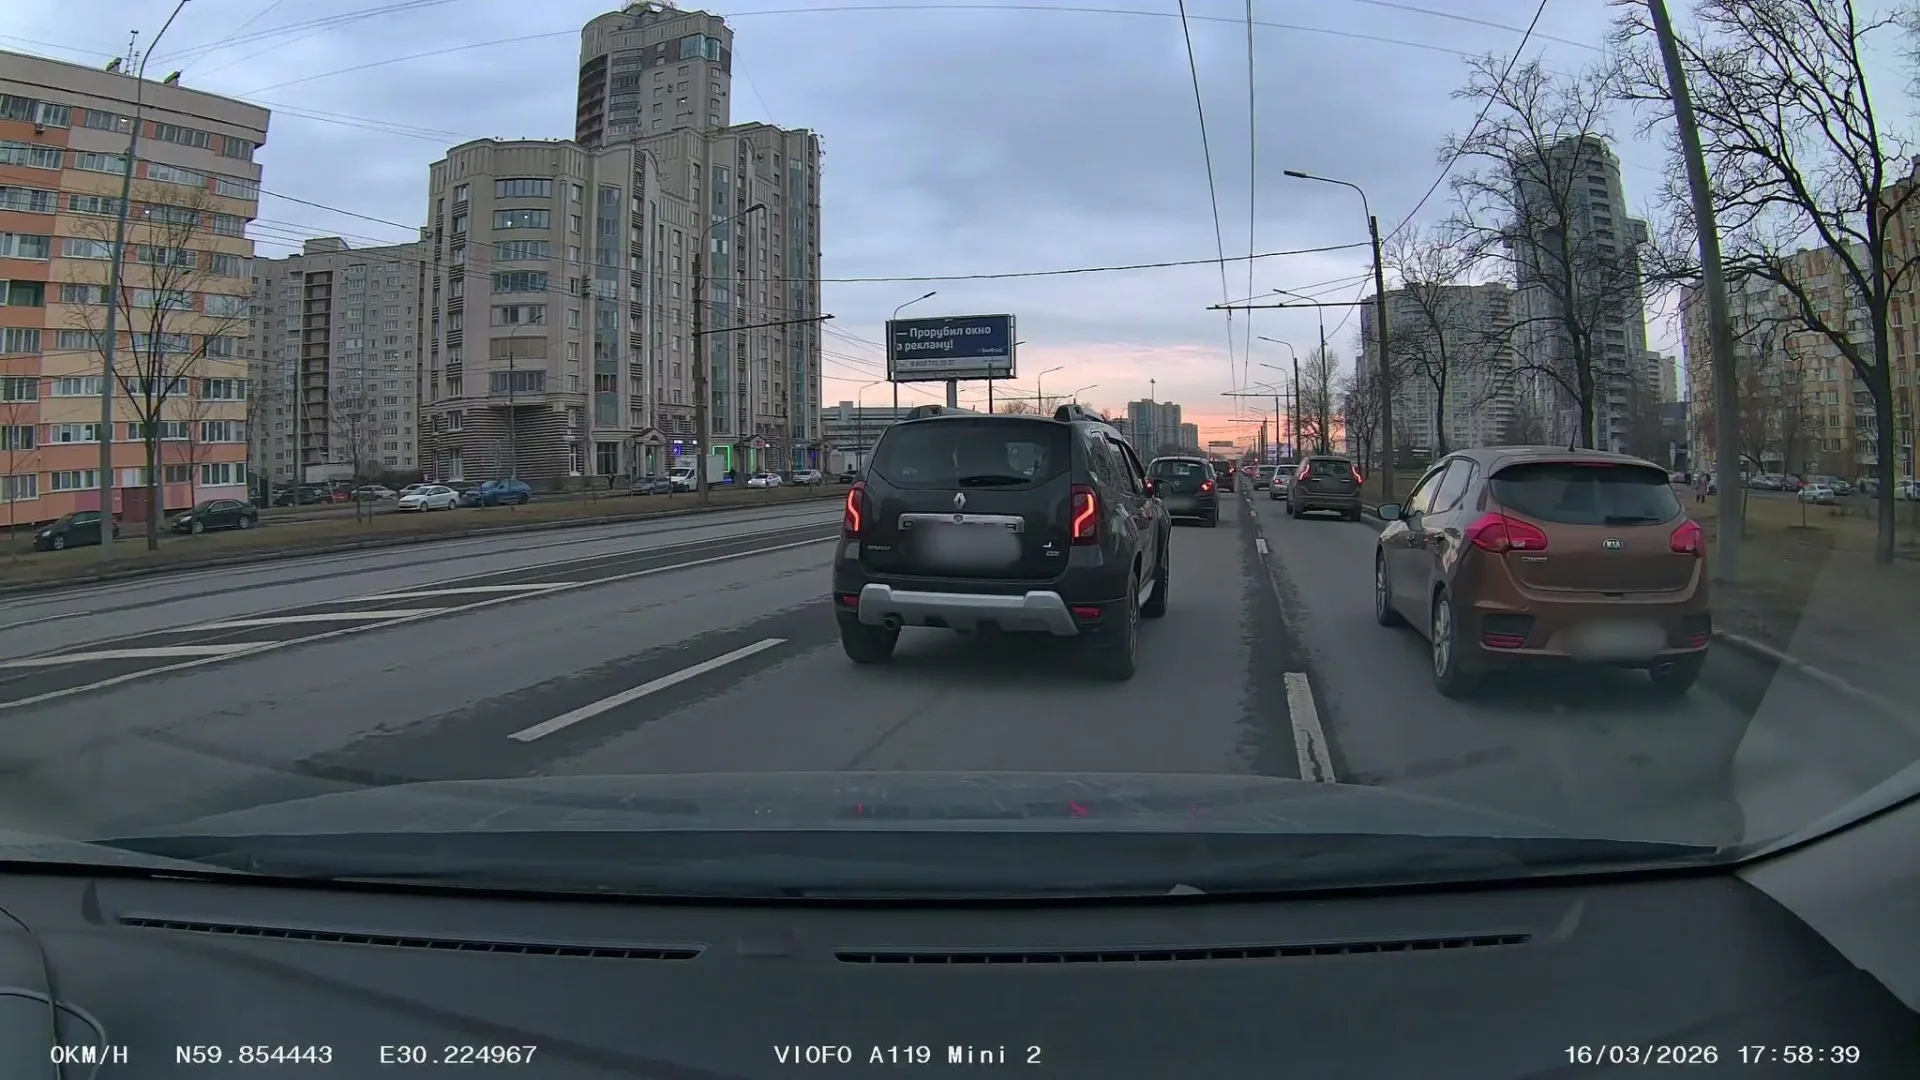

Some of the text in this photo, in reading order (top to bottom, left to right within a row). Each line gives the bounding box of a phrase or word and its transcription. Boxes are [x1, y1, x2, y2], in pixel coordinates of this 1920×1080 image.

[909, 326, 963, 339] Прорубил
[965, 326, 991, 335] окно
[905, 339, 954, 352] рекламу!
